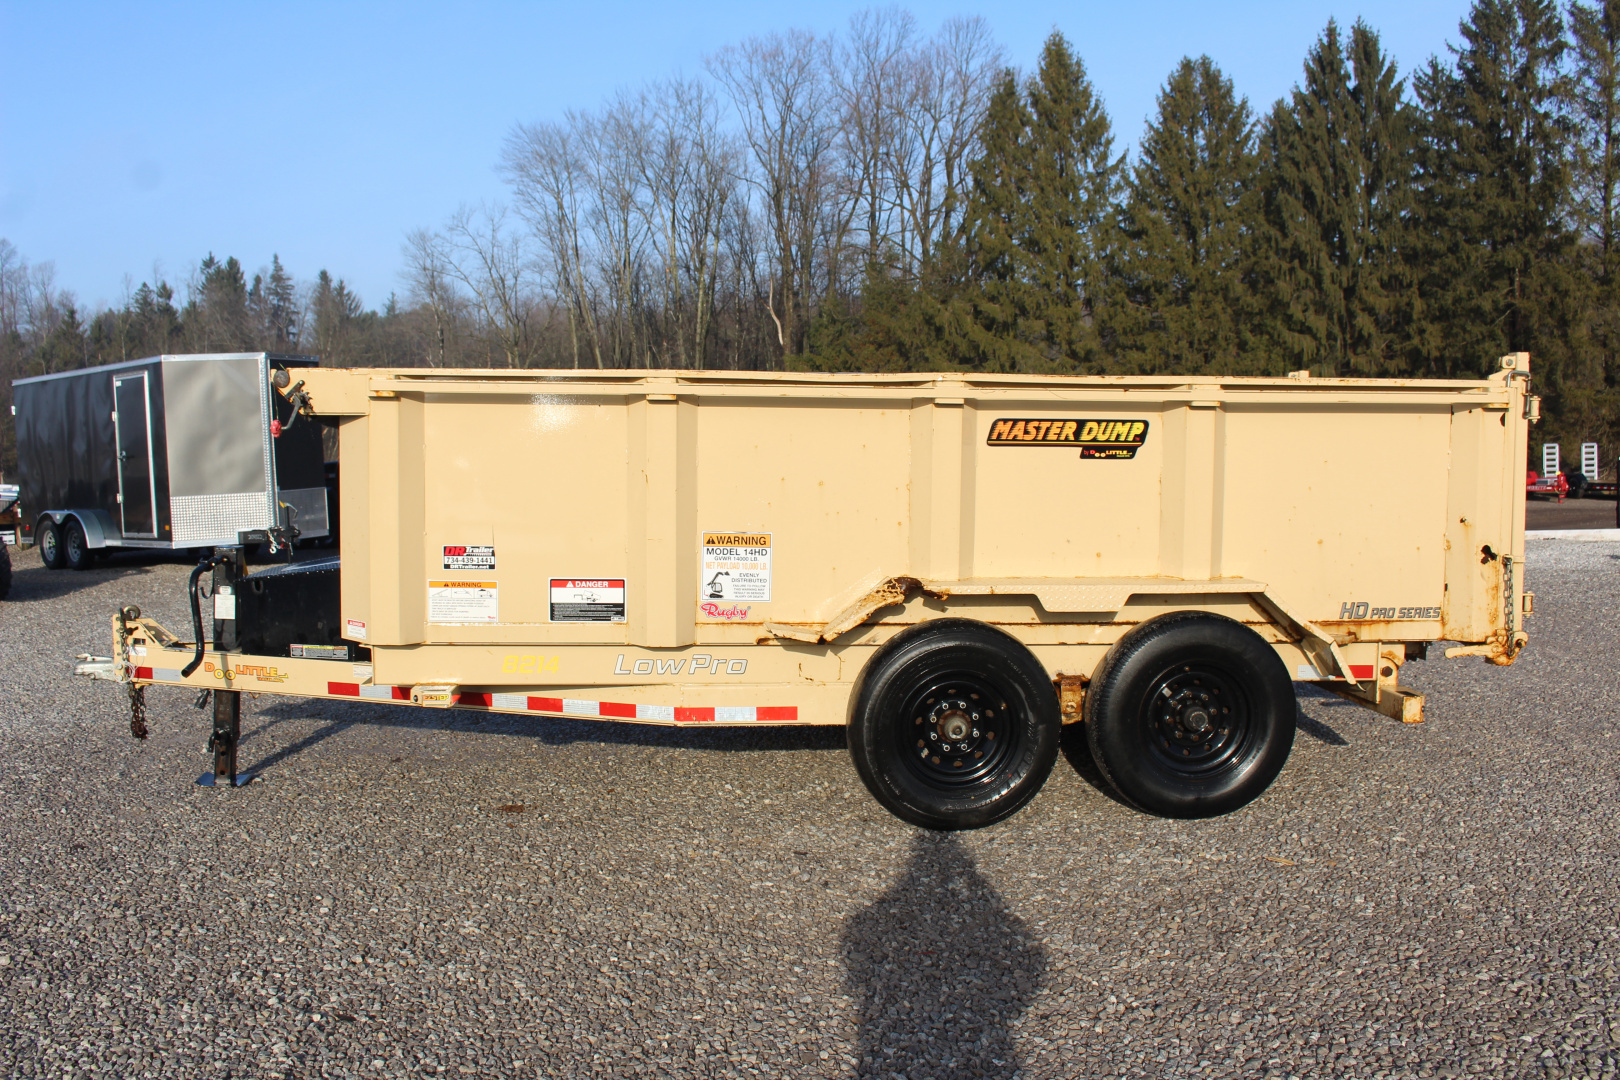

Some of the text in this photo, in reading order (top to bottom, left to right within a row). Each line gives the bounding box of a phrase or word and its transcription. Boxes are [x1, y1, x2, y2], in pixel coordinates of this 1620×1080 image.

[990, 420, 1145, 441] MASTER DUMP
[716, 535, 767, 545] WARNING
[706, 547, 768, 556] MODEL 14HD
[706, 561, 716, 569] NET
[717, 562, 740, 570] PAYLOAD
[575, 580, 609, 588] DANGER
[700, 602, 748, 620] Rugby
[1339, 602, 1441, 619] HD PRO SERIES
[502, 655, 560, 674] 8214
